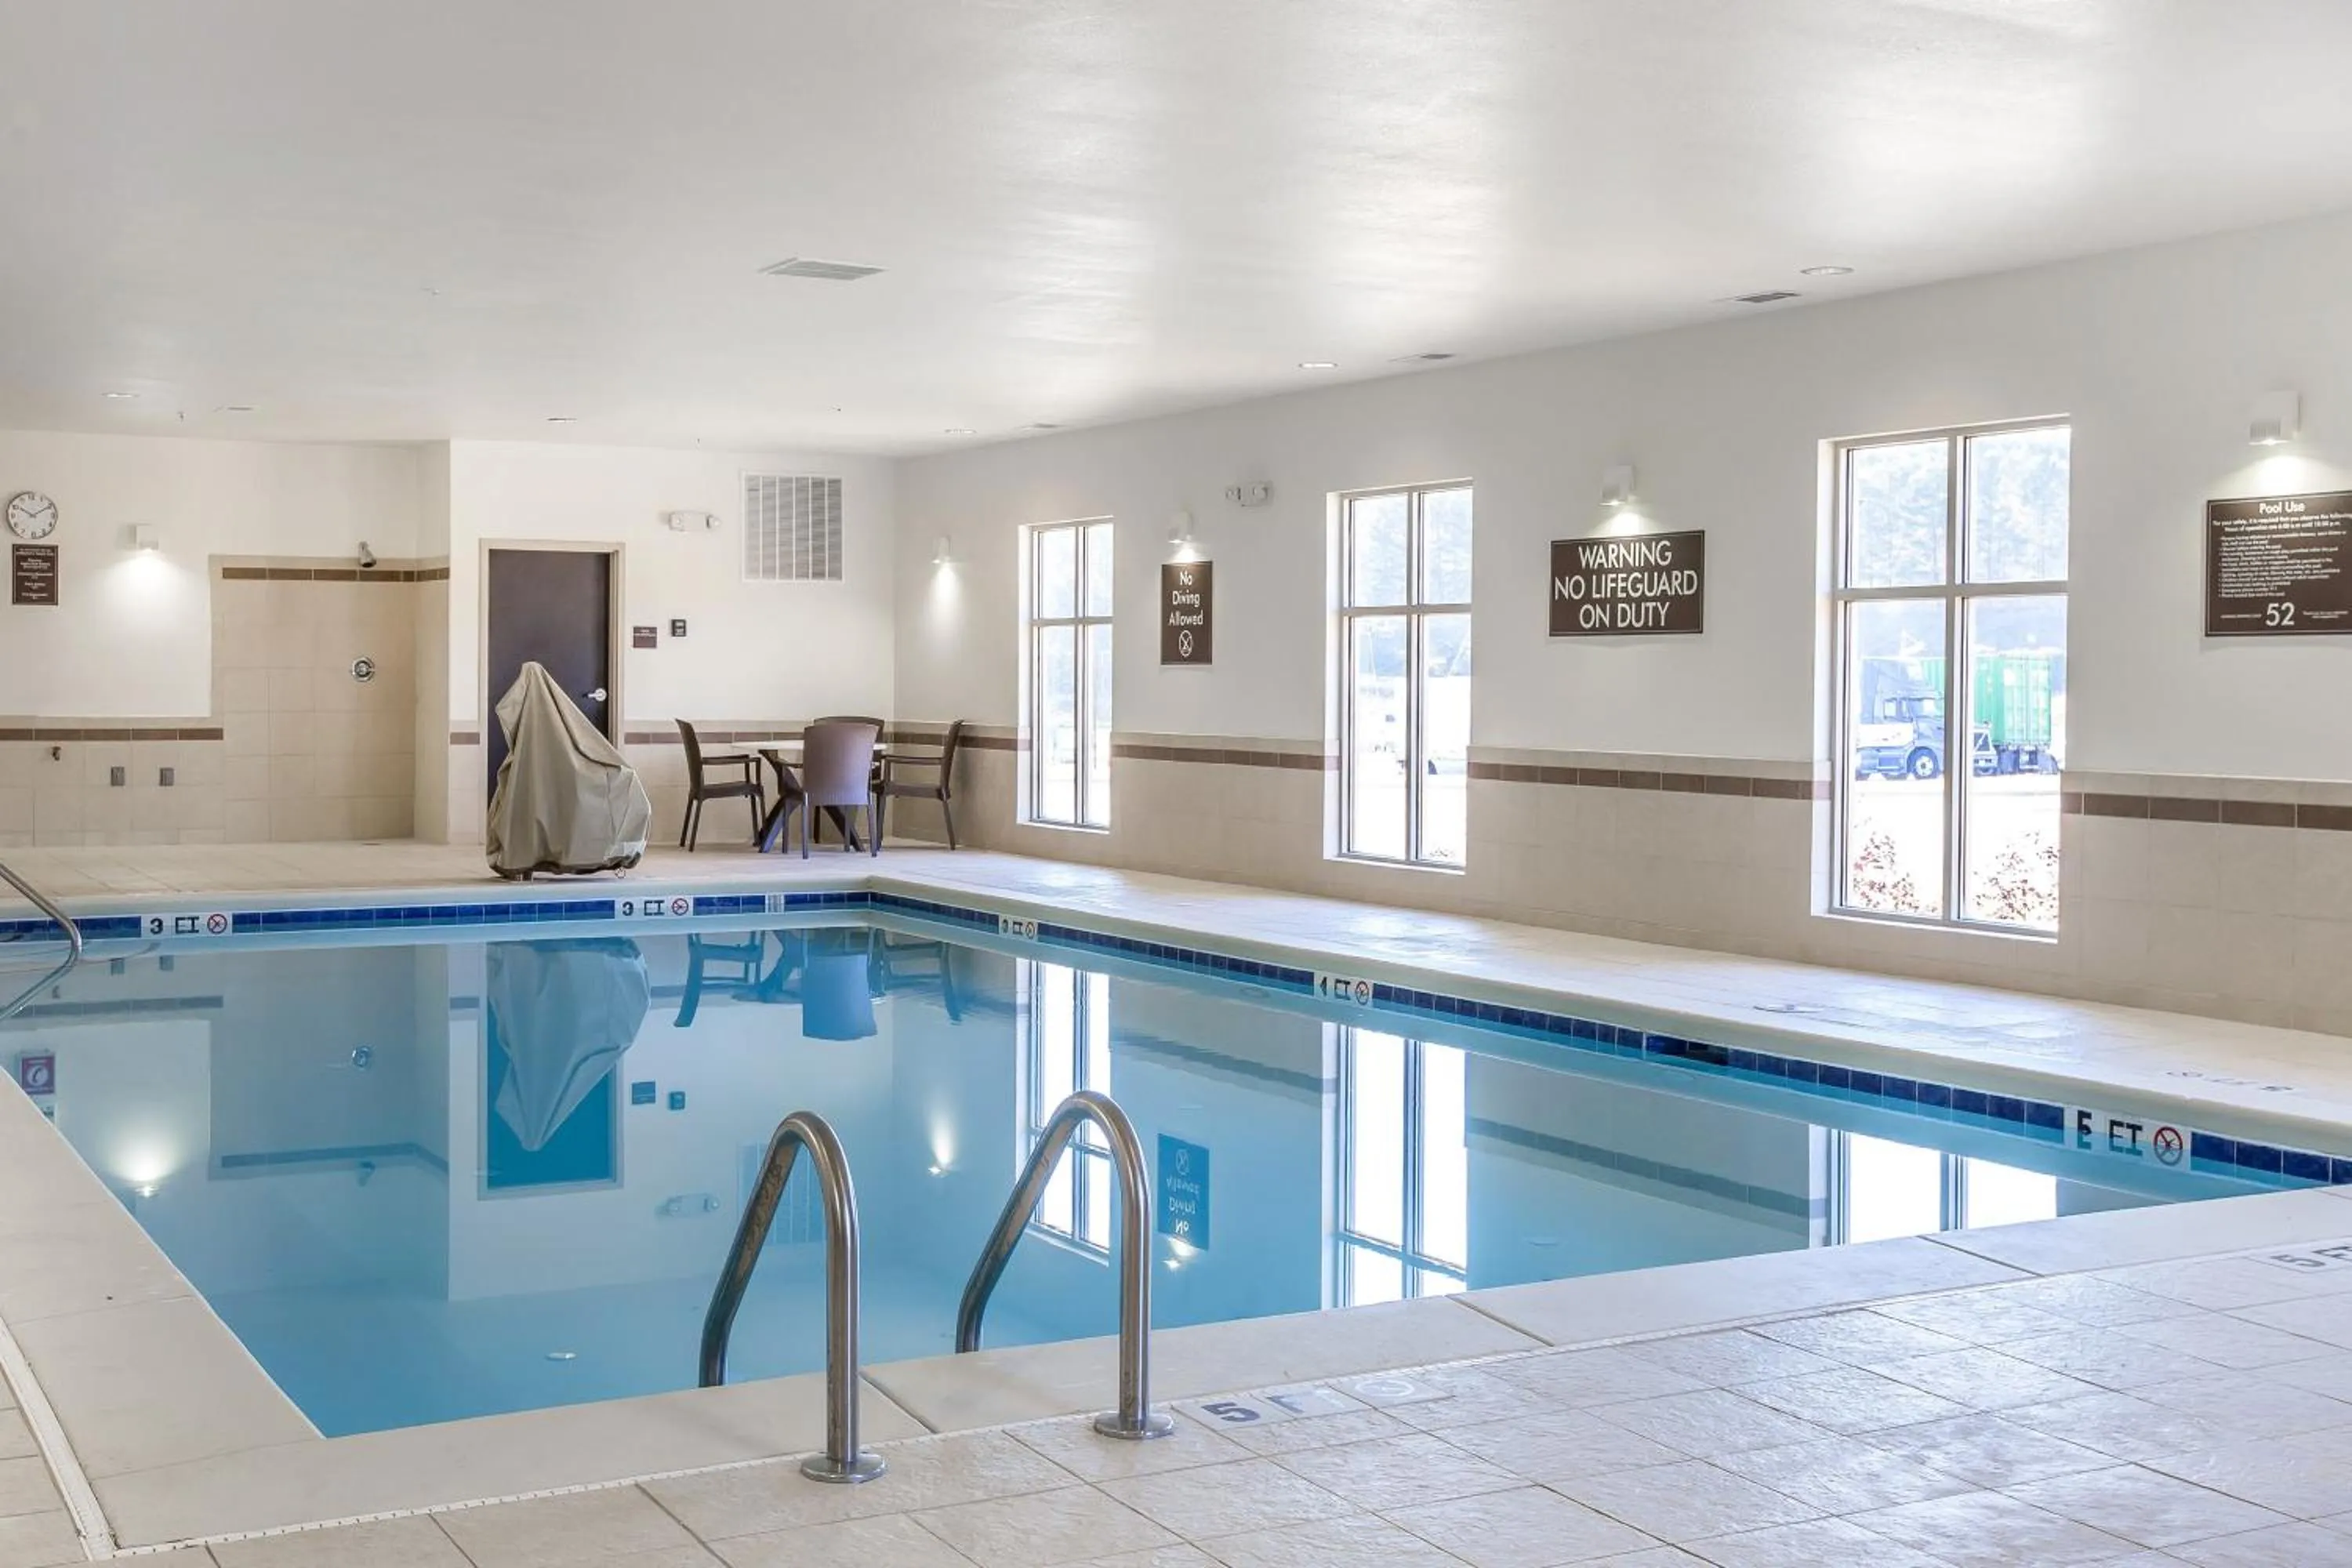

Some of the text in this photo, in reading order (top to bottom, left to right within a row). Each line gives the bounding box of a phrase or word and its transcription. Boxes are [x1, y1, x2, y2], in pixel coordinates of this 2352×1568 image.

[2259, 500, 2306, 514] Pool Use
[1578, 540, 1672, 569] WARNING
[1180, 570, 1192, 586] No
[1555, 570, 1698, 601] NO LIFEGUARD
[1172, 590, 1200, 608] Diving
[1169, 609, 1203, 626] Allowed
[1579, 601, 1670, 629] ON DUTY
[2265, 602, 2295, 626] 52
[2270, 1254, 2326, 1268] 5
[1201, 1402, 1261, 1422] 5
